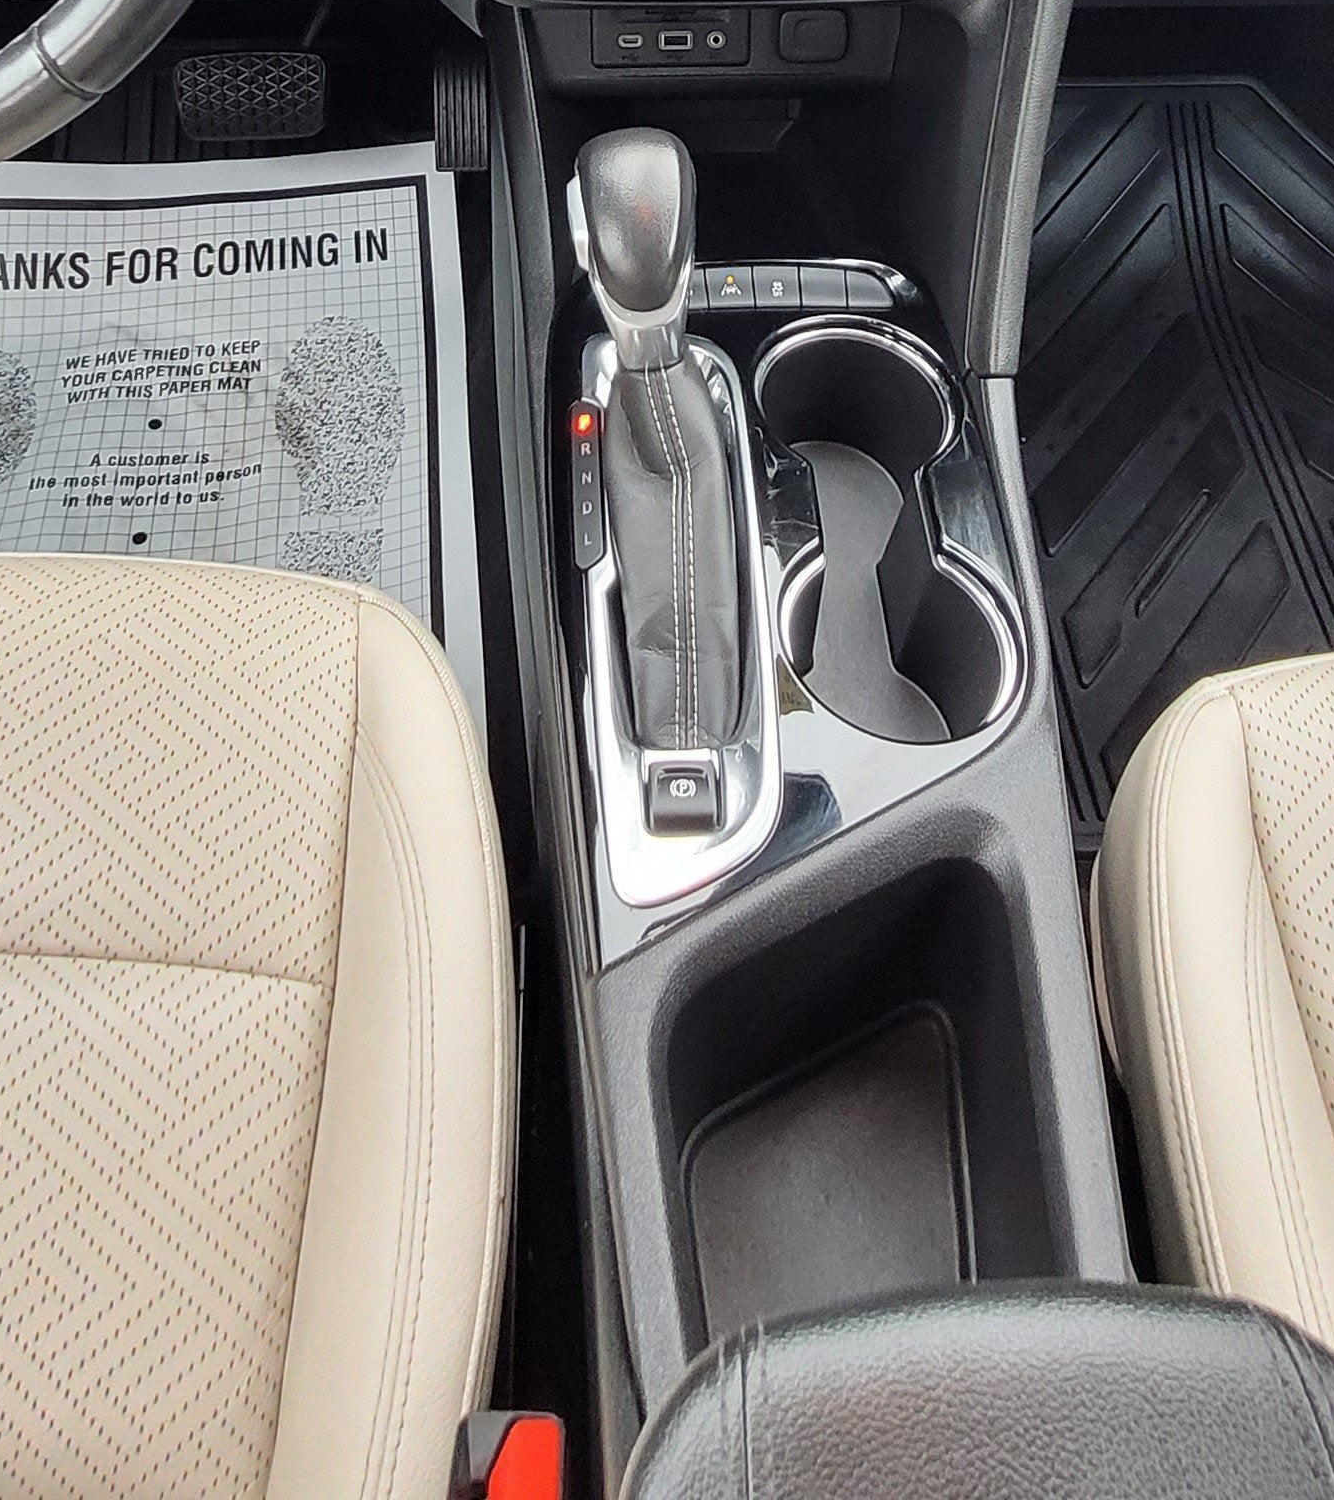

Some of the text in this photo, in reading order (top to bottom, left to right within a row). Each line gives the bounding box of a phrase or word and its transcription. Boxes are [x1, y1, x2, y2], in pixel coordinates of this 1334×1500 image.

[105, 247, 179, 287] FOR
[193, 232, 340, 278] COMING
[353, 227, 389, 264] IN
[66, 339, 261, 370] WE HAVE TRIED TO KEEP
[61, 359, 262, 389] YOUR CARPETING CLEAN
[67, 376, 253, 404] WITH THIS PAPER MAT
[580, 442, 592, 456] R
[88, 451, 211, 467] A customer is
[28, 463, 262, 491] the most important person
[581, 470, 592, 486] N
[62, 489, 225, 508] in the world to us.
[582, 500, 593, 515] D
[583, 532, 593, 546] L
